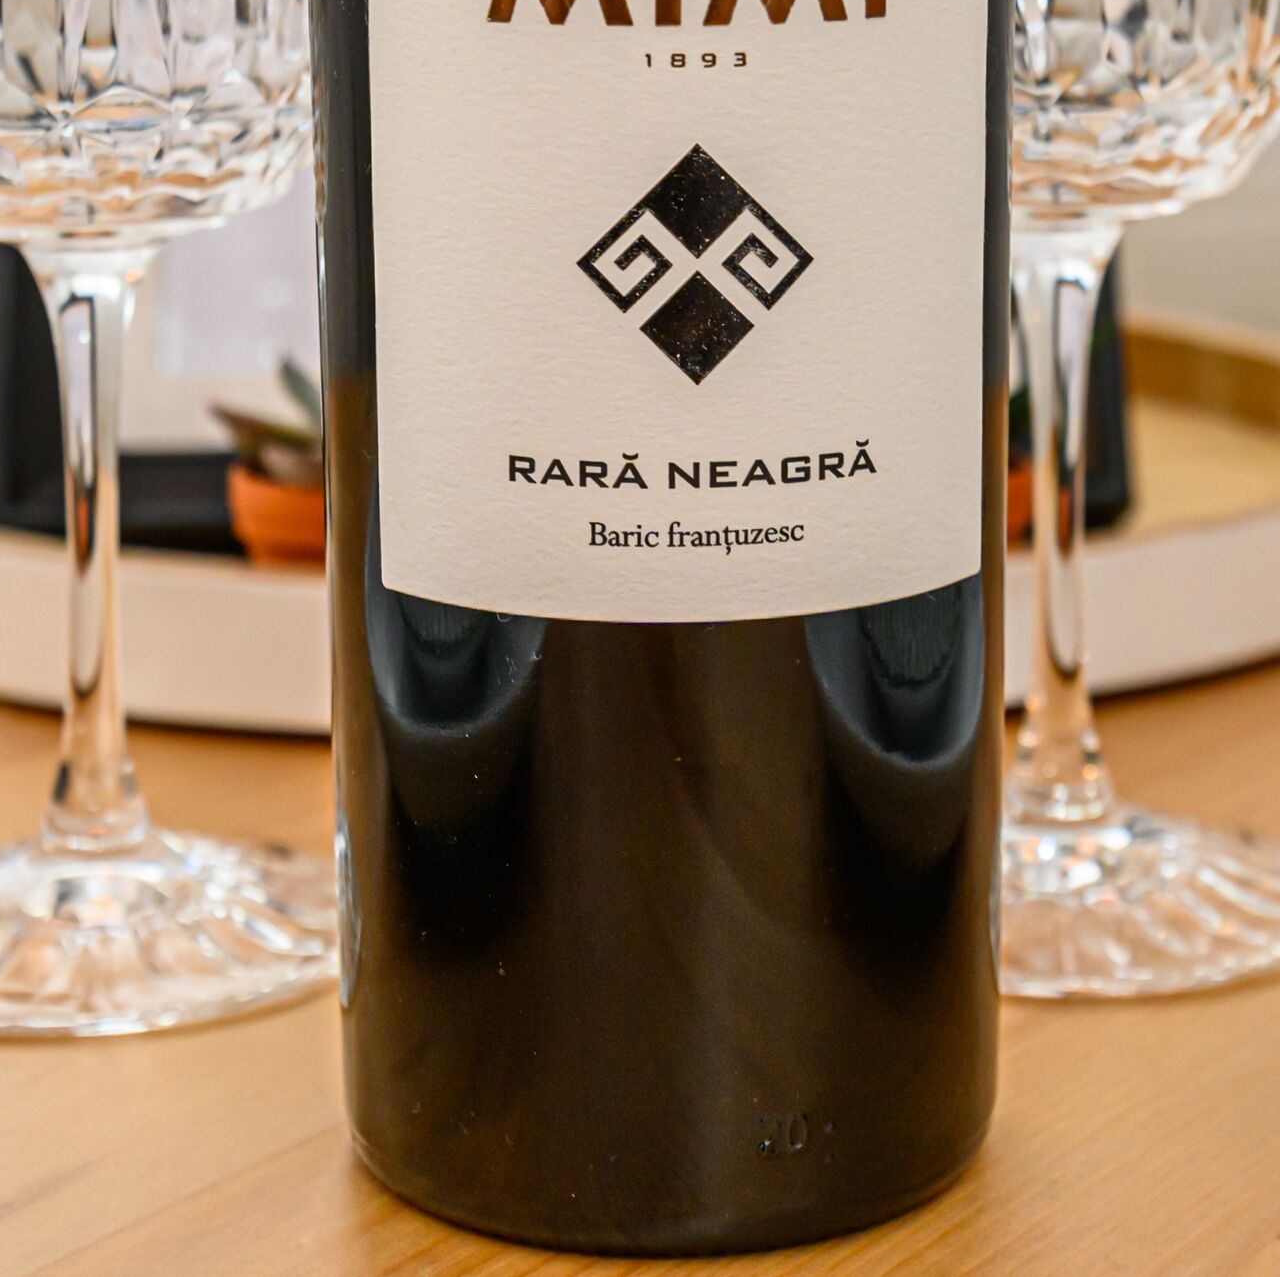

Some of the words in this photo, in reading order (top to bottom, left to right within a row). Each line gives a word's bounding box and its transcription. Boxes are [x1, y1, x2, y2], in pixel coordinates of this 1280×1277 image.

[644, 52, 748, 69] 1893
[508, 452, 649, 490] RARĂ
[667, 438, 878, 490] NEAGRĂ
[588, 521, 660, 548] Baric
